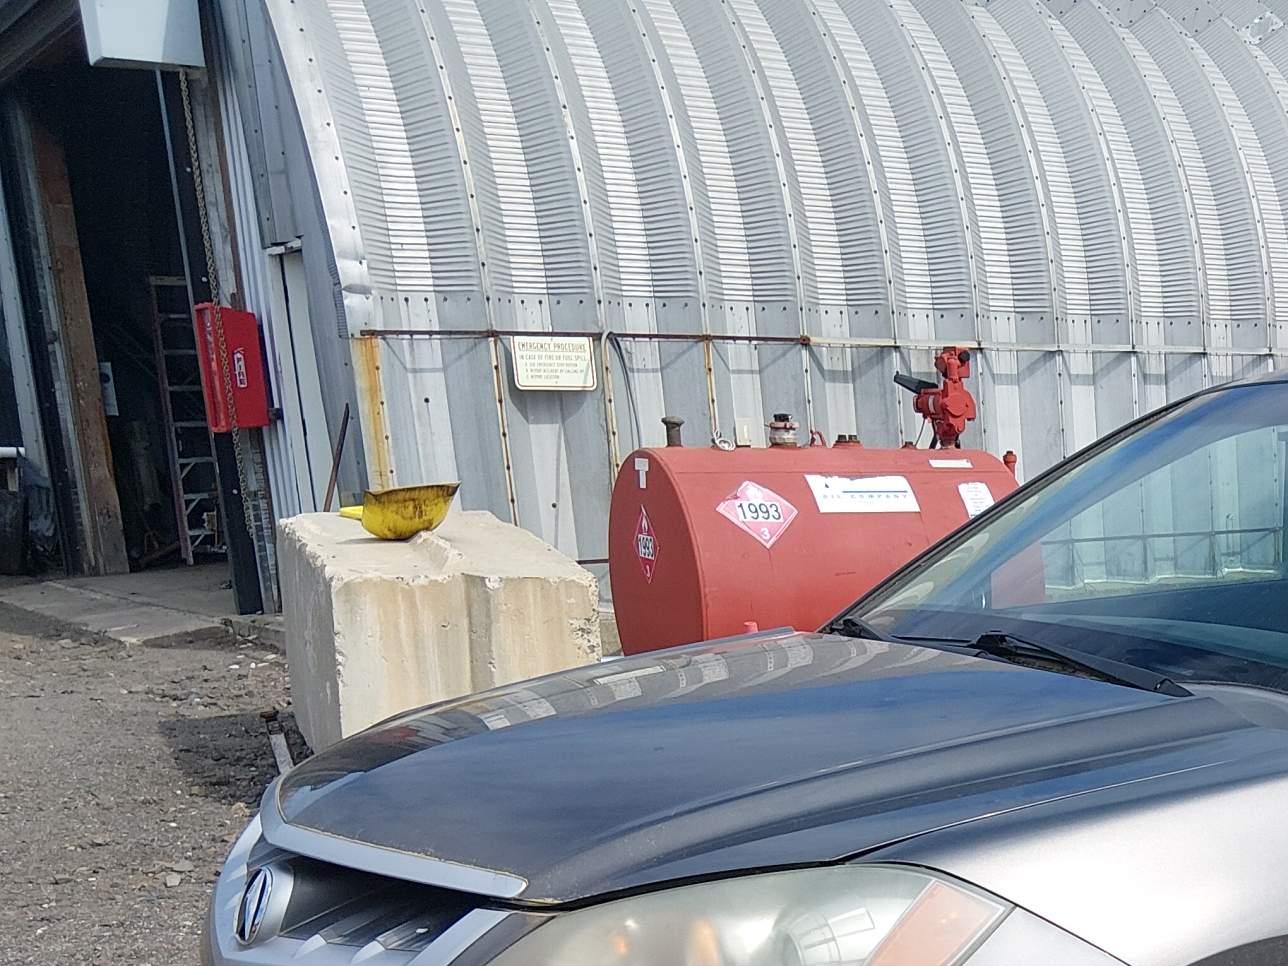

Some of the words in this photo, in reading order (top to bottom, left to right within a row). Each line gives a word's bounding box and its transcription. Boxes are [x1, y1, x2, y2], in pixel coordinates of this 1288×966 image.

[518, 342, 551, 351] EMERGENCY
[553, 342, 587, 352] PROCEDURE
[738, 502, 782, 520] 1993
[760, 527, 771, 540] 3
[639, 536, 654, 558] 1993
